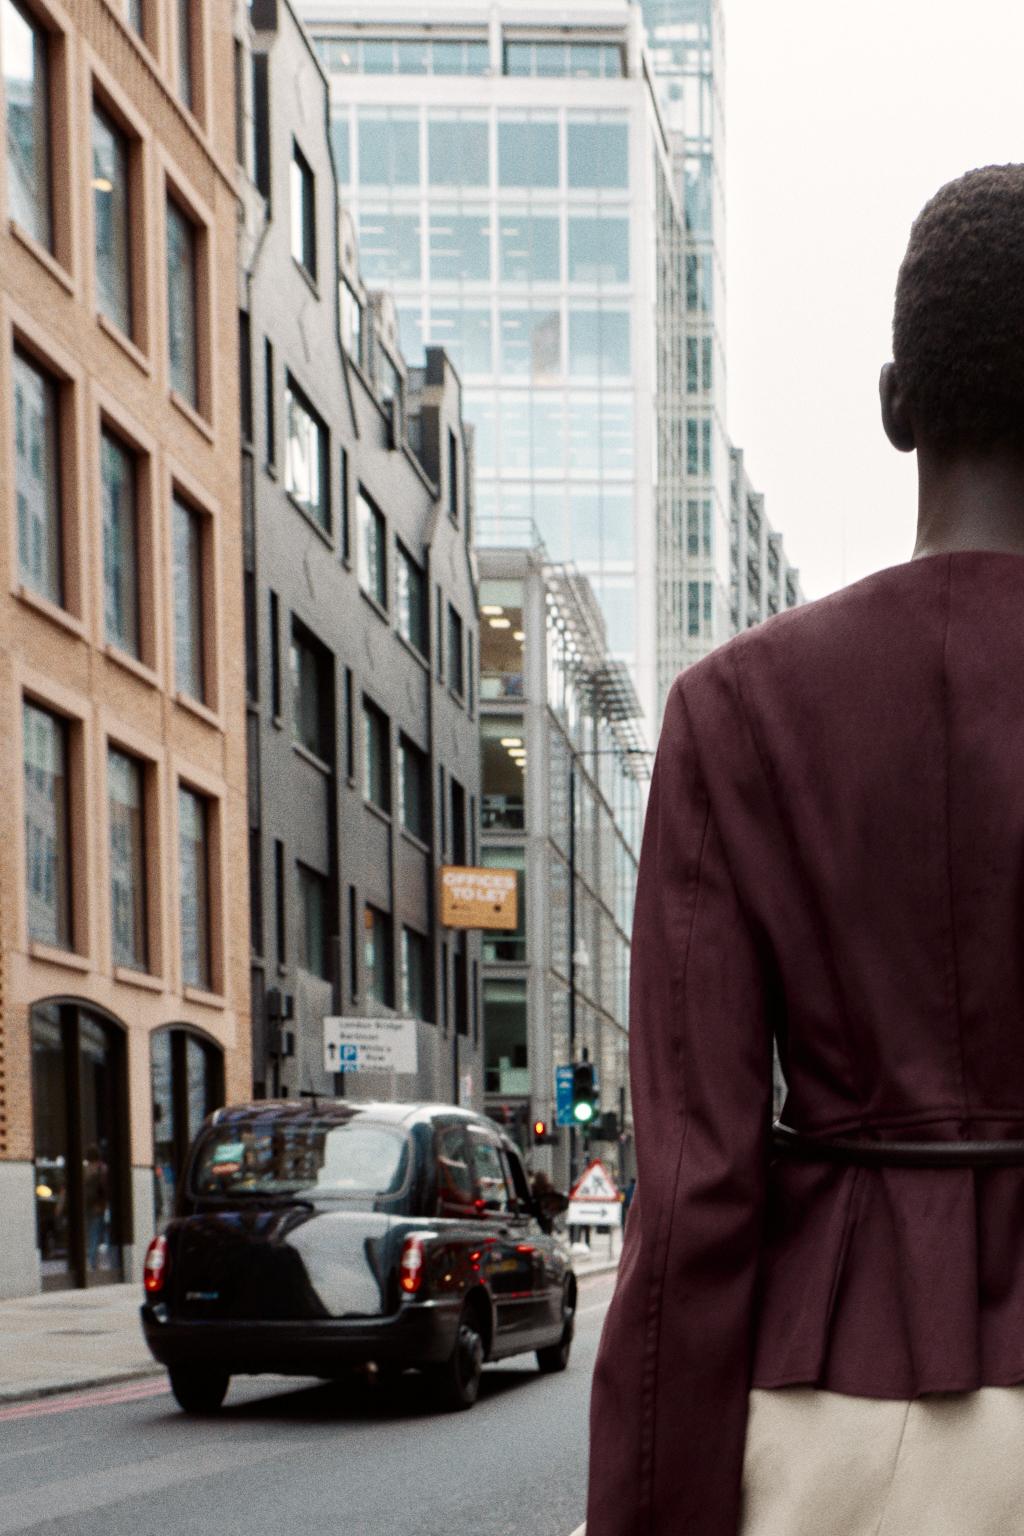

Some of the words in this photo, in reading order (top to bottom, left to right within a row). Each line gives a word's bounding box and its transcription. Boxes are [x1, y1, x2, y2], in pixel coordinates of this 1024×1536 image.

[443, 872, 516, 889] OFFICES
[450, 887, 475, 901] TO
[477, 888, 508, 903] LET
